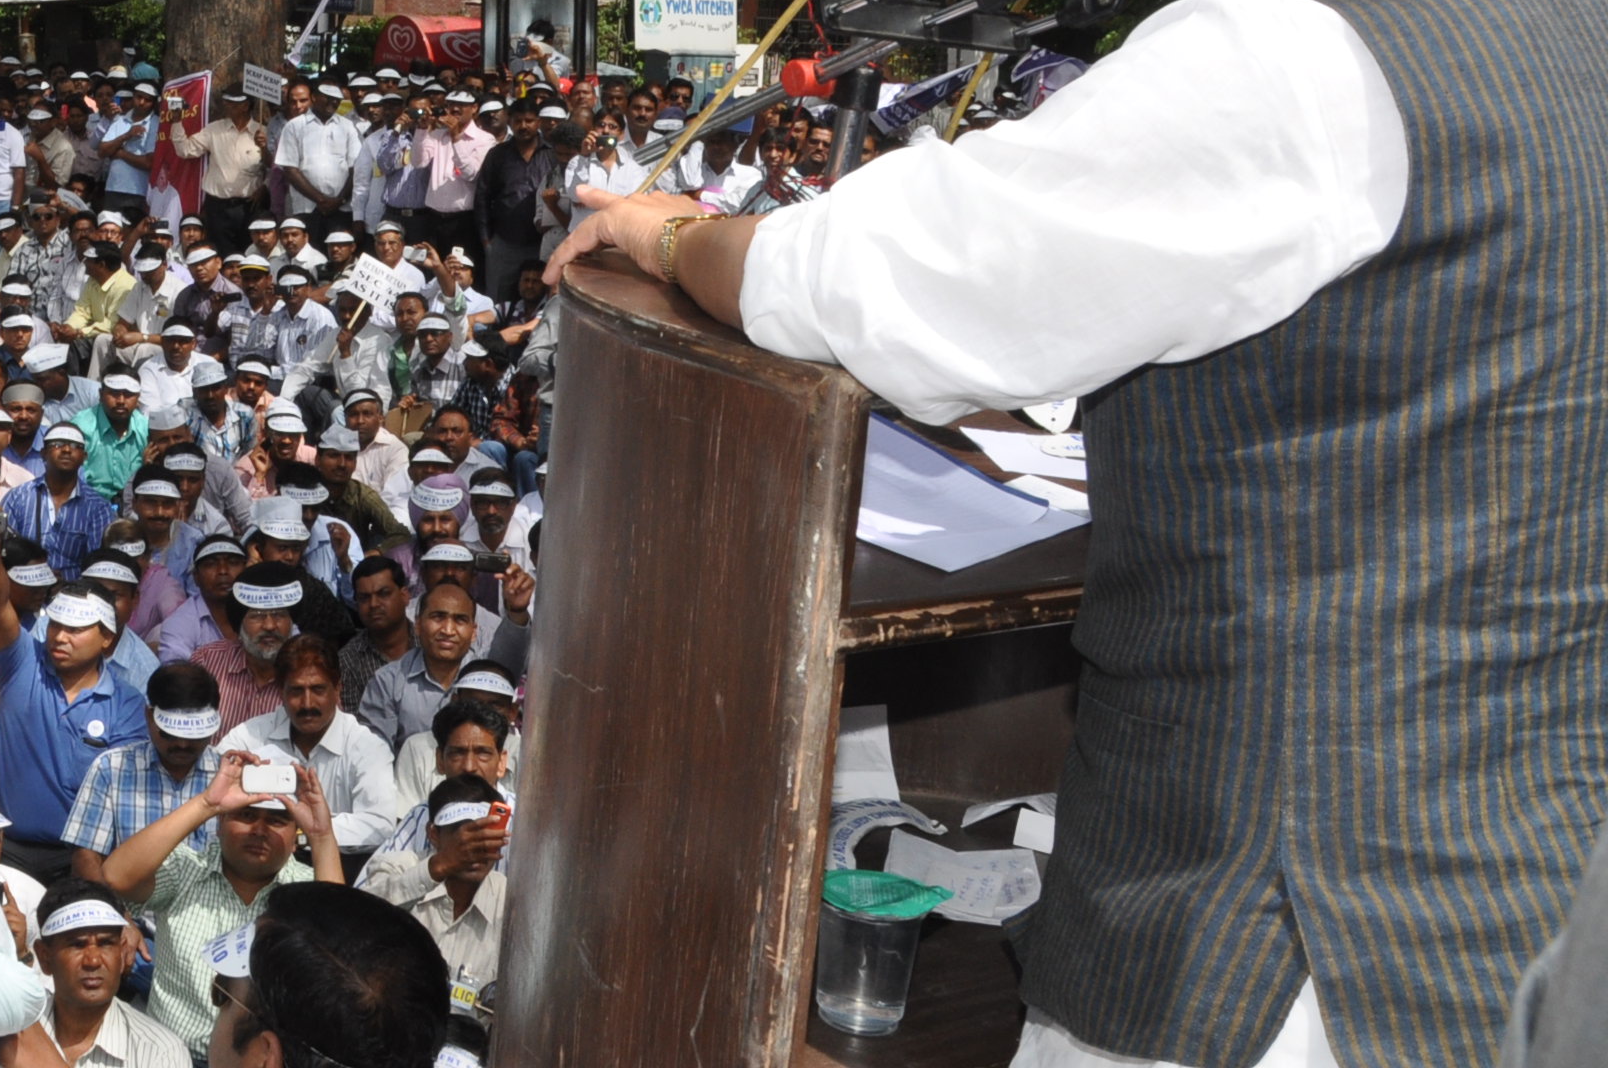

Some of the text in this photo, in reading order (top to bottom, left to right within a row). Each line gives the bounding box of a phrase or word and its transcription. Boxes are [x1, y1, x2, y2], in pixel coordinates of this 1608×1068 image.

[694, 0, 734, 16] KITCHEN
[246, 68, 281, 86] SCRAP SCRAP
[351, 280, 366, 293] AS
[239, 591, 283, 600] PARLIAMENT
[156, 713, 205, 727] PARLIAMENT
[453, 987, 474, 1002] LIC
